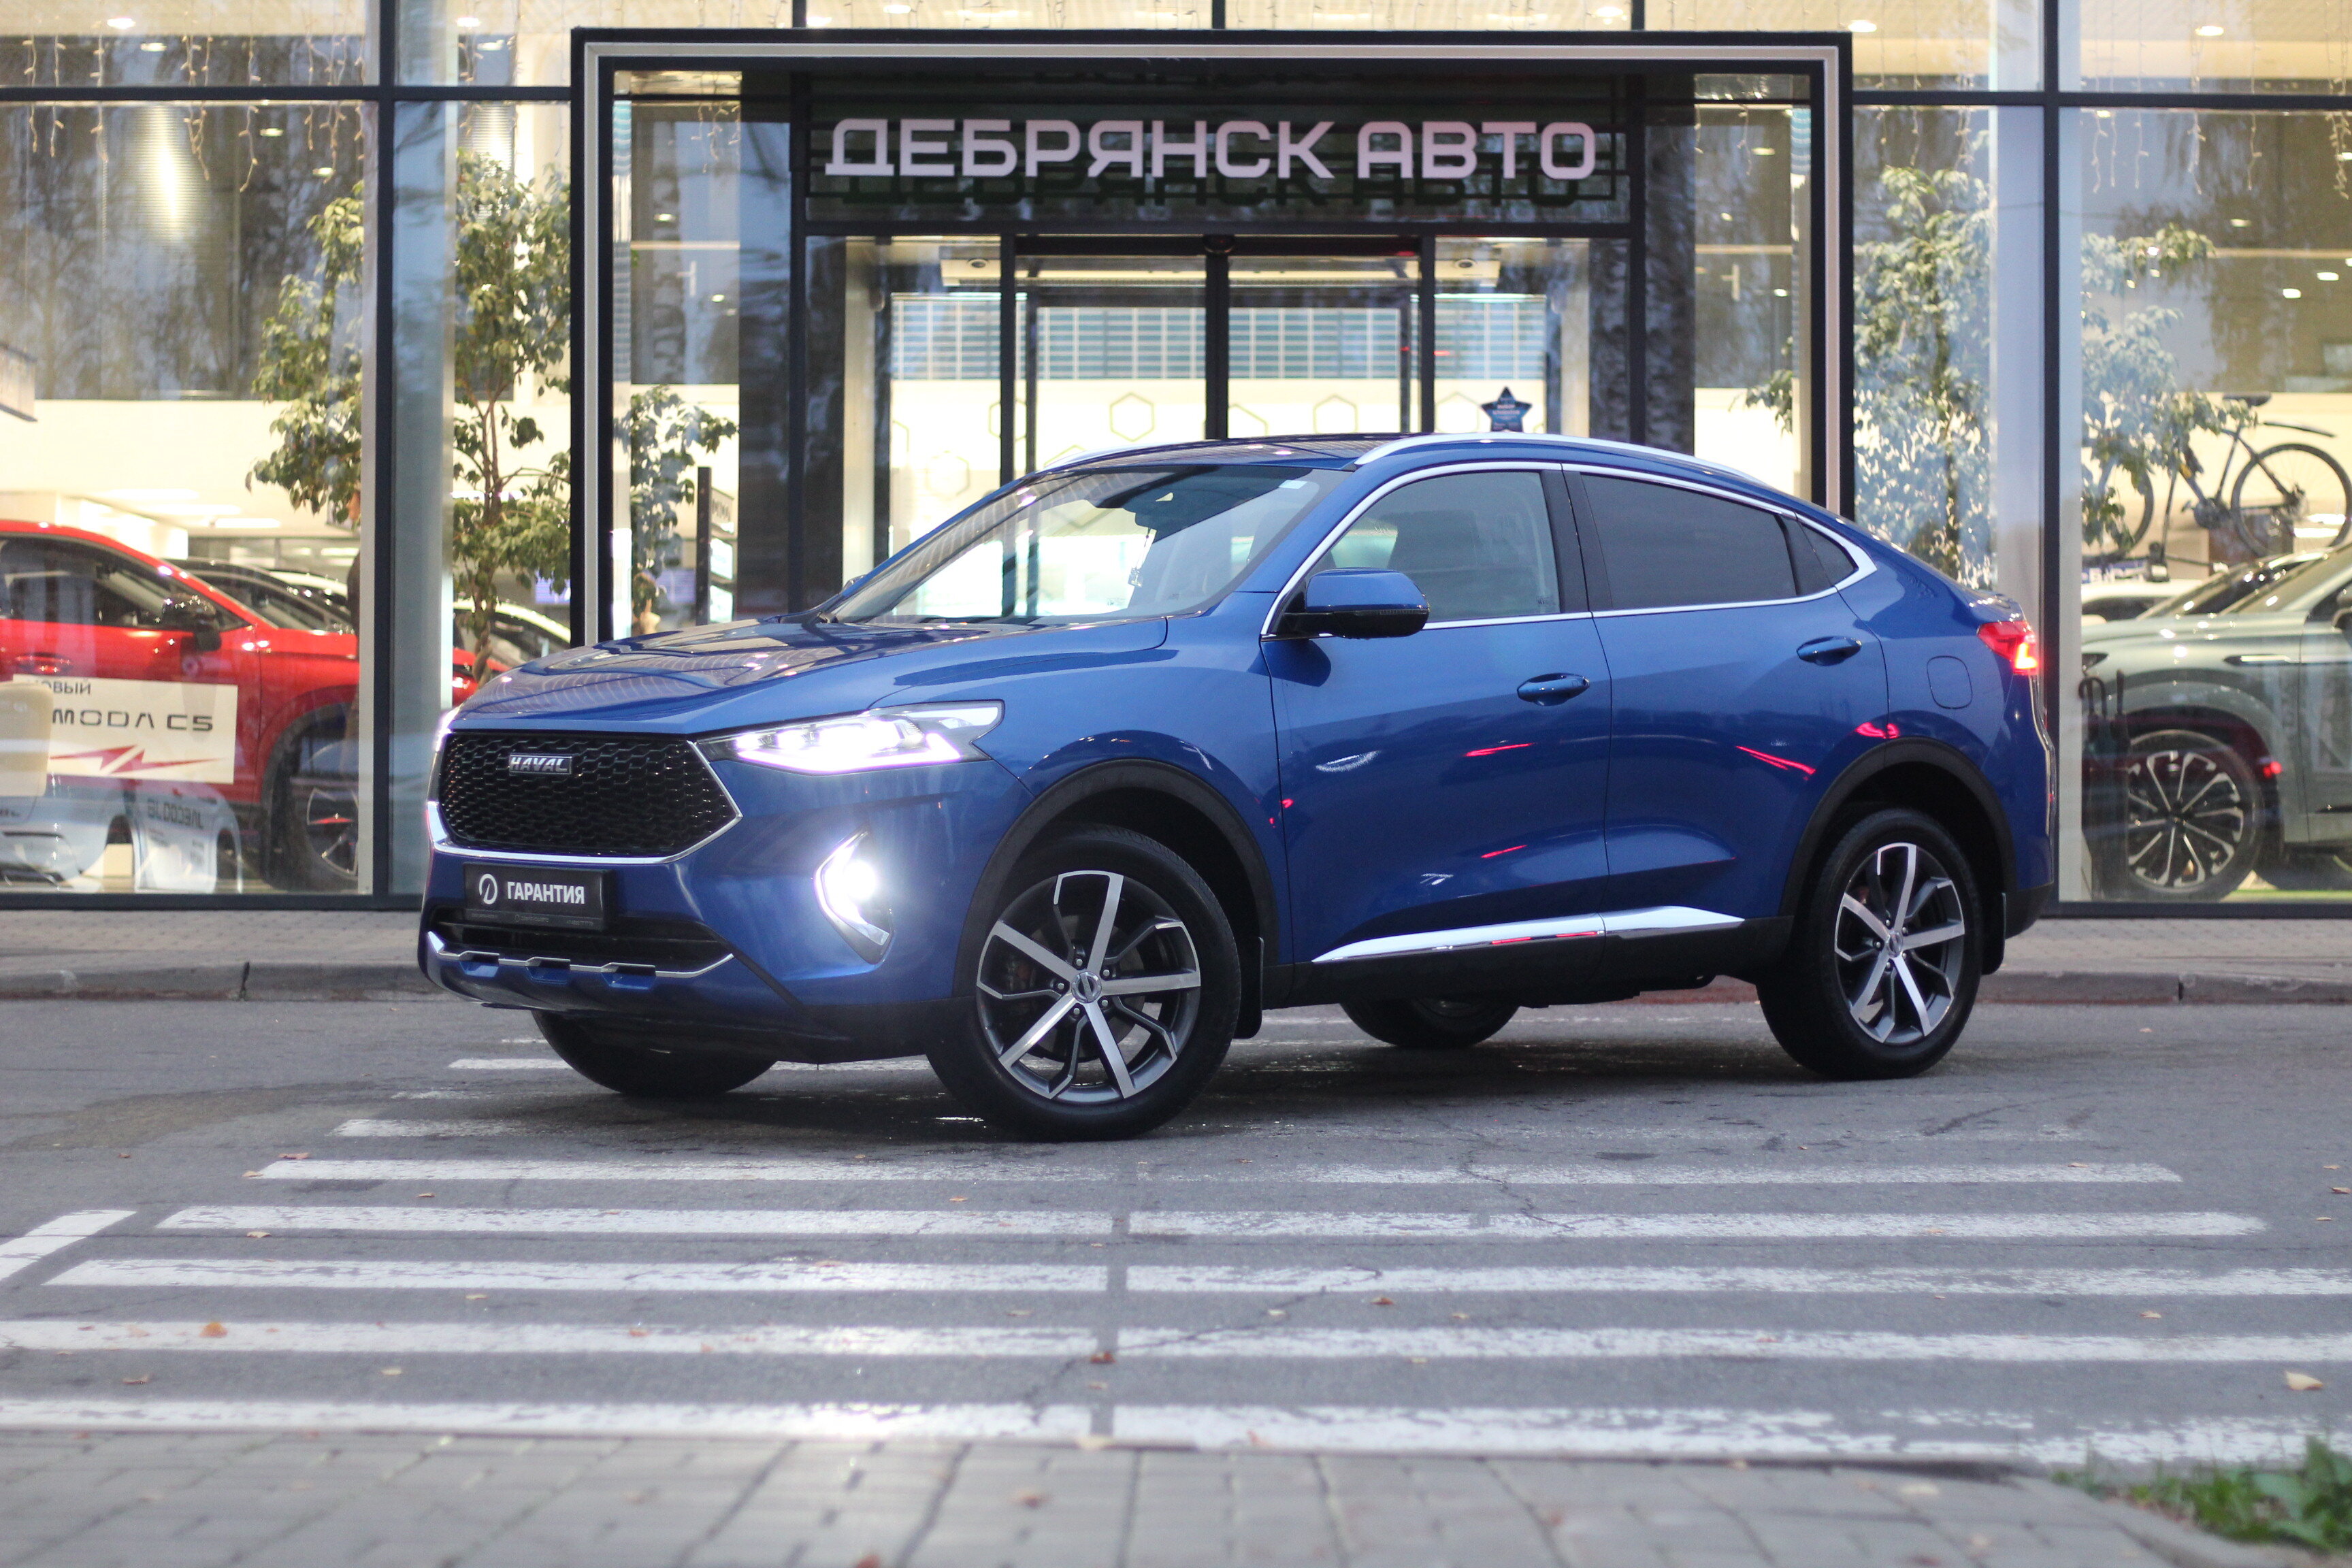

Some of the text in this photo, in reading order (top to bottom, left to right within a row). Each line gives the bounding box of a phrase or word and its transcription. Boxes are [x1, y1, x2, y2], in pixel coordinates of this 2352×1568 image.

[824, 118, 1597, 180] ДЕБРЯНСК АВТО
[40, 678, 92, 695] ВЫЙ
[52, 708, 213, 732] MODA C5
[509, 756, 569, 772] HAVAL
[507, 881, 585, 904] ГАРАНТИЯ
